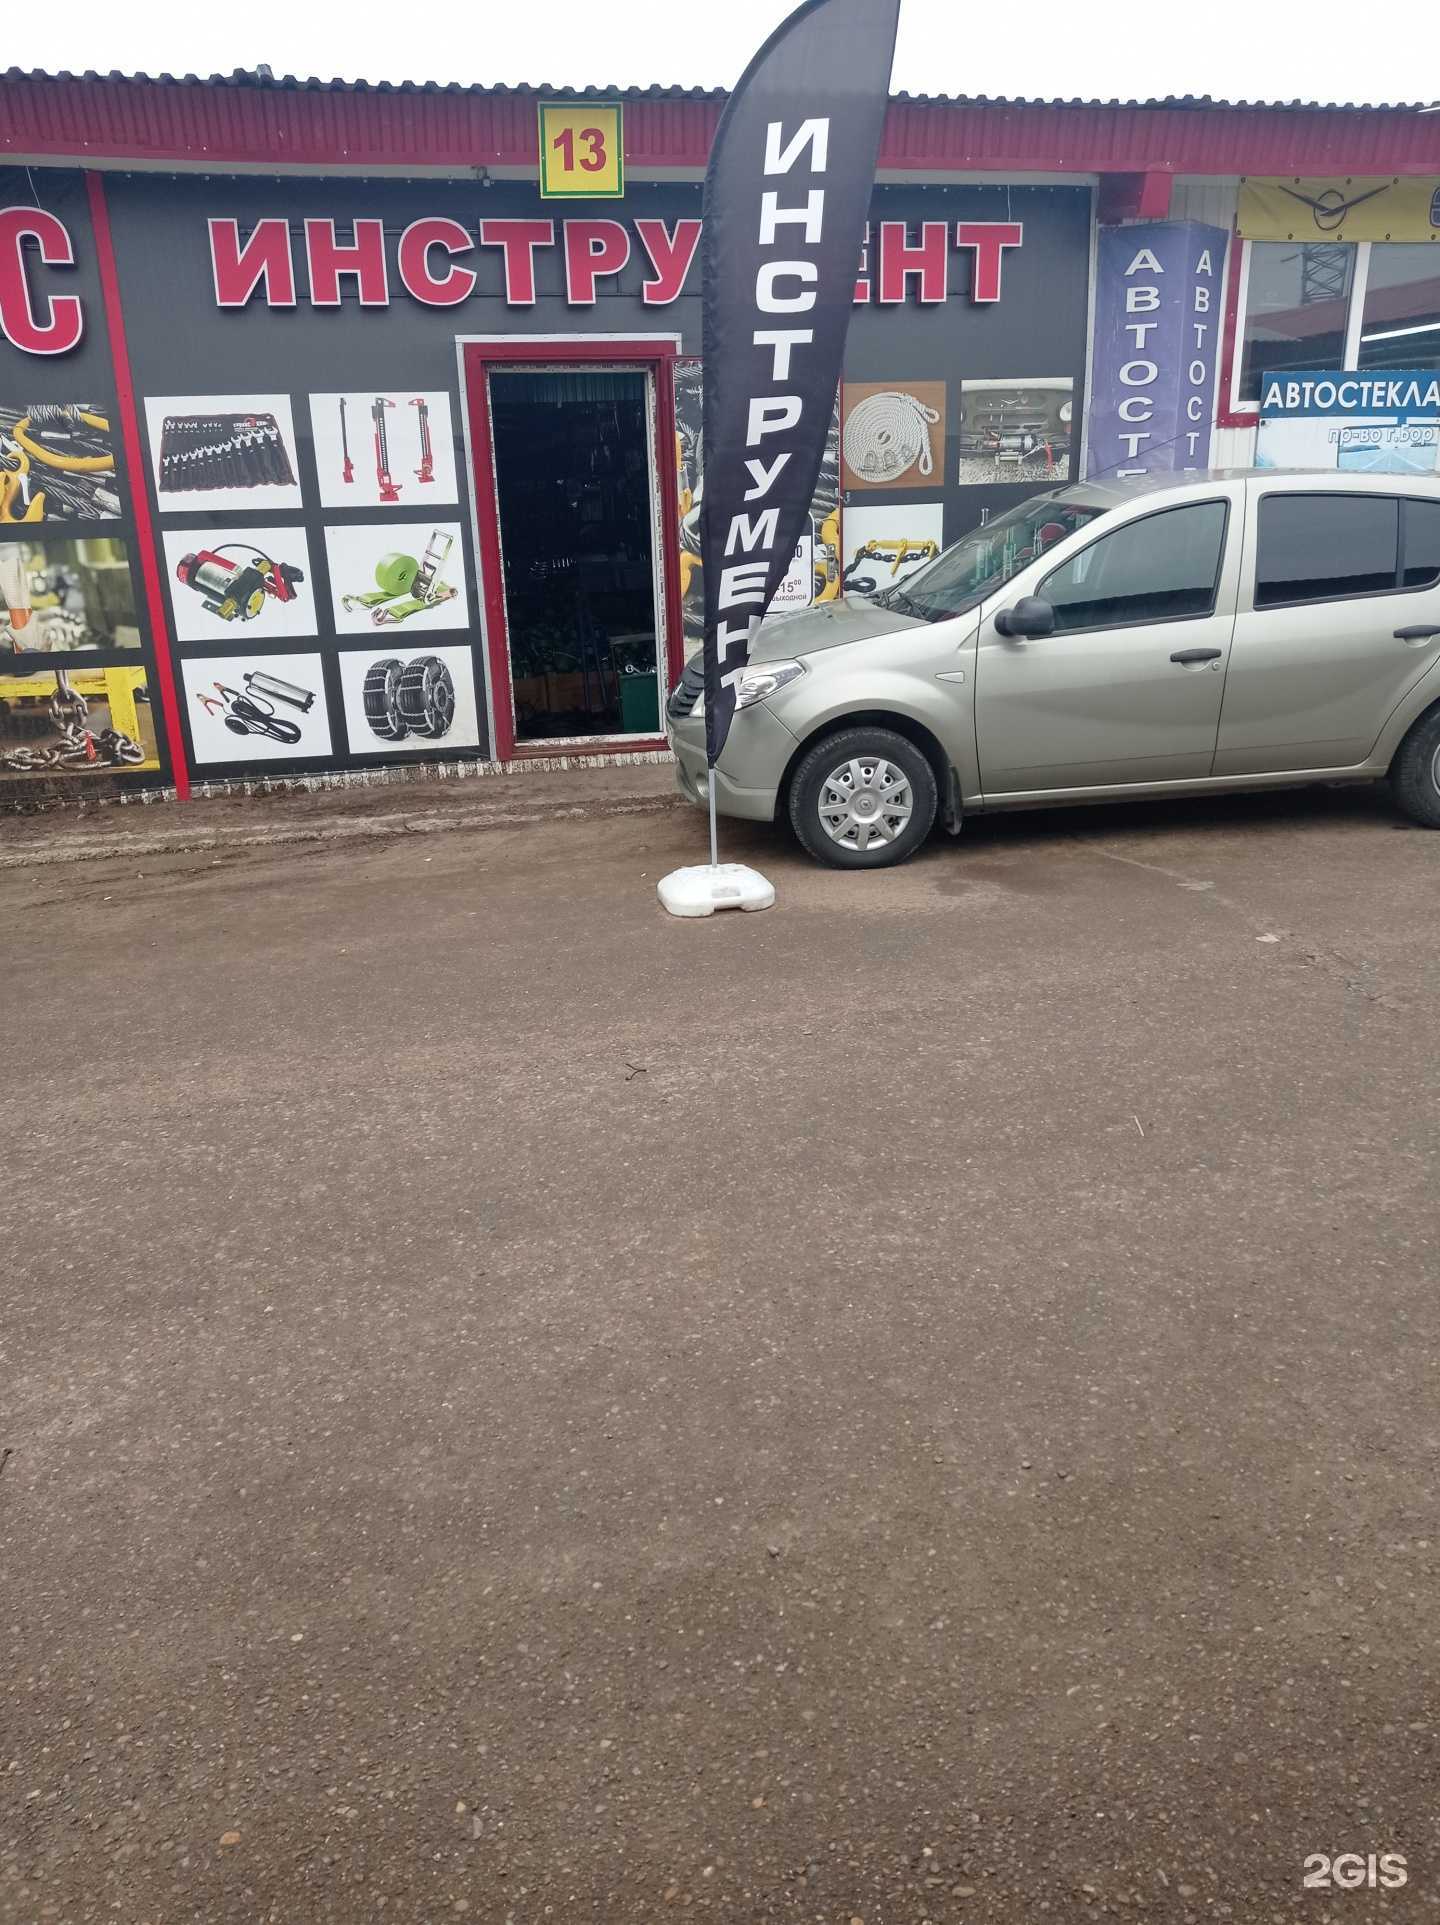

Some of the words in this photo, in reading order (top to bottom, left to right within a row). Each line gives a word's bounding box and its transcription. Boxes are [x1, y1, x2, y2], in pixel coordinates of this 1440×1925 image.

[553, 127, 606, 171] 13
[207, 217, 1023, 306] ИНСТРУНТ
[1118, 249, 1164, 478] АВТОСТ
[1184, 250, 1212, 471] АВТОСТ
[1263, 381, 1440, 409] АВТОСТЕКЛА
